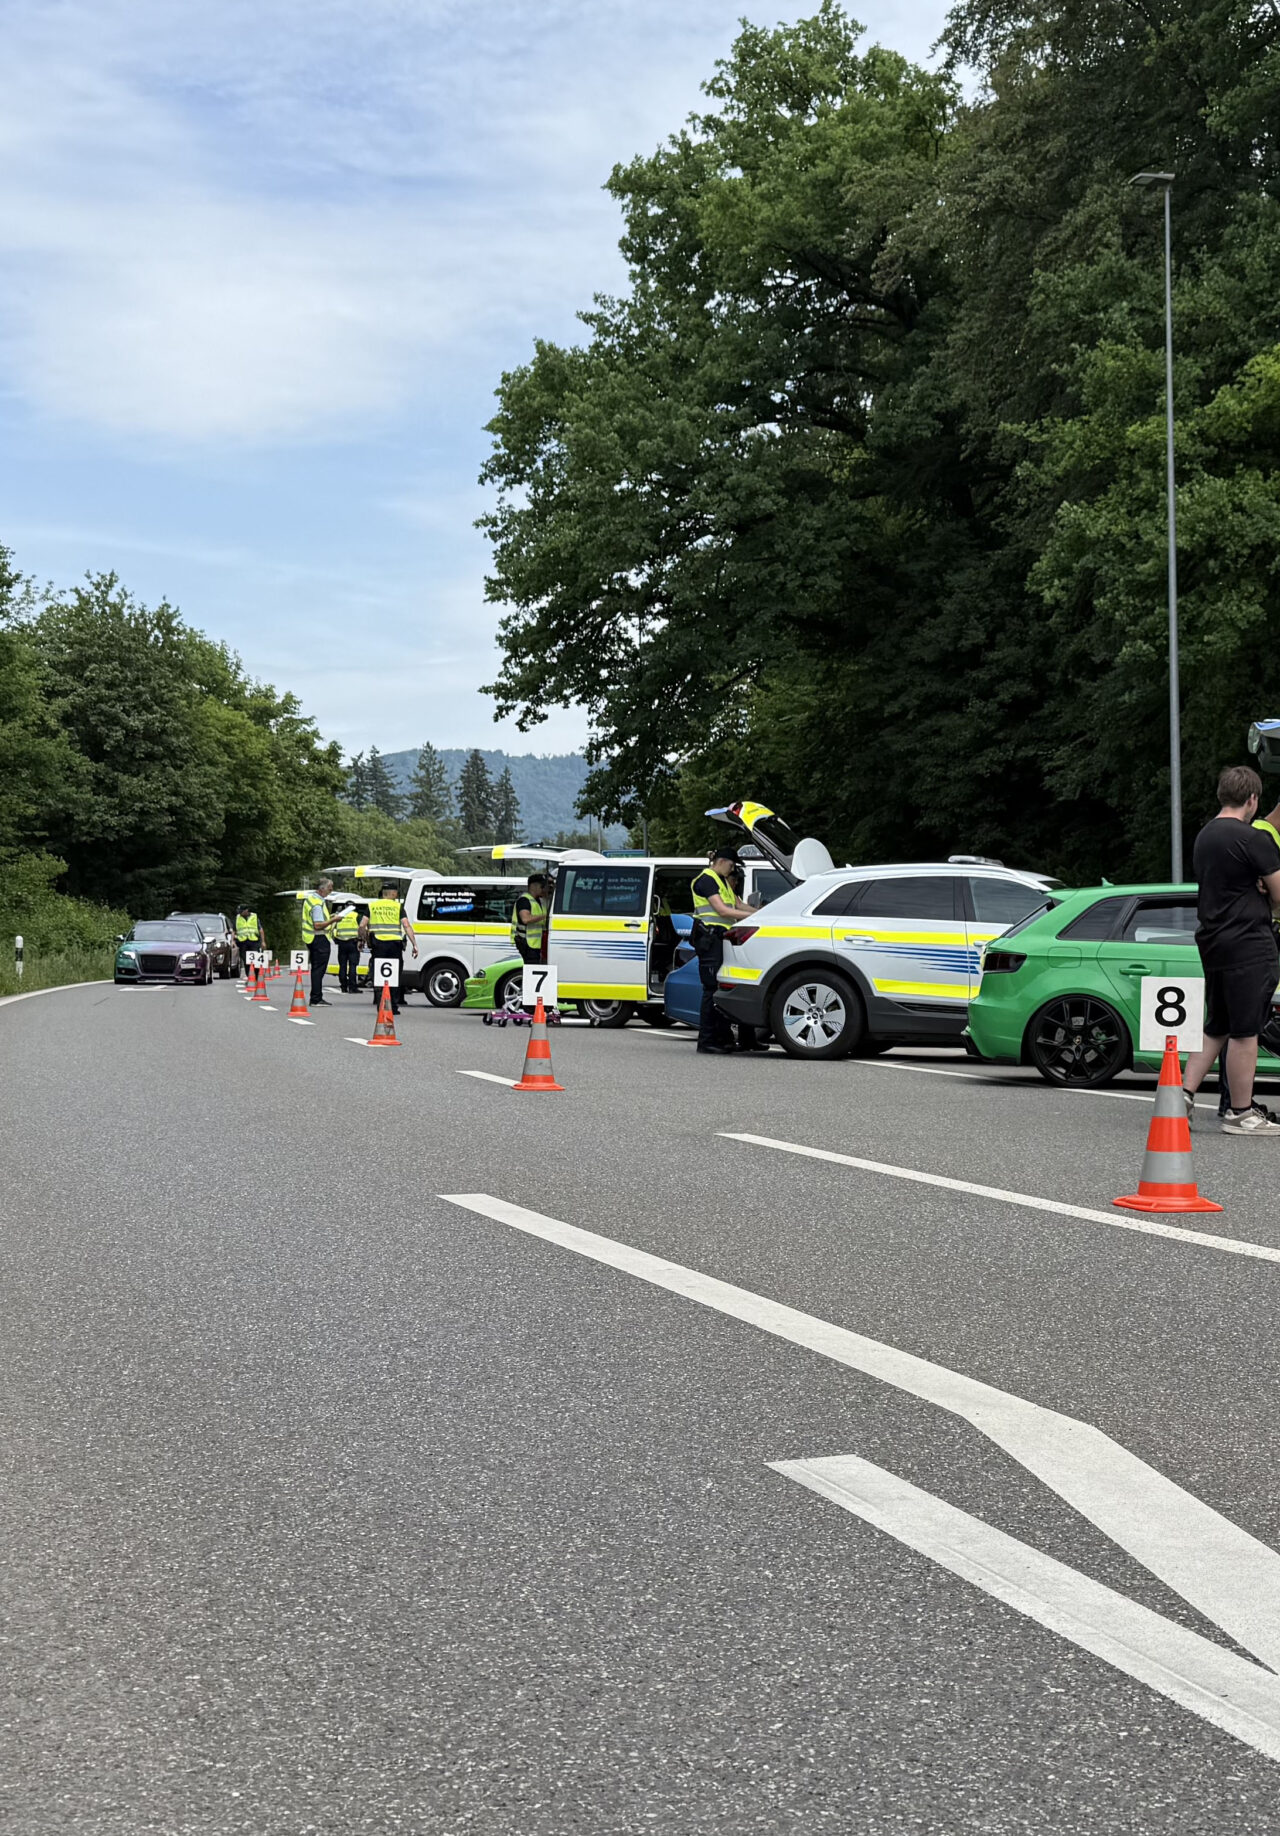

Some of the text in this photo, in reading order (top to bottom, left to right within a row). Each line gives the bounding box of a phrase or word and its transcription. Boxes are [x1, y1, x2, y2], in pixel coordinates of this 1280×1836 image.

[257, 954, 265, 963] 4
[295, 952, 304, 964] 5
[380, 962, 393, 978] 6
[532, 970, 549, 993] 7
[1154, 986, 1187, 1027] 8
